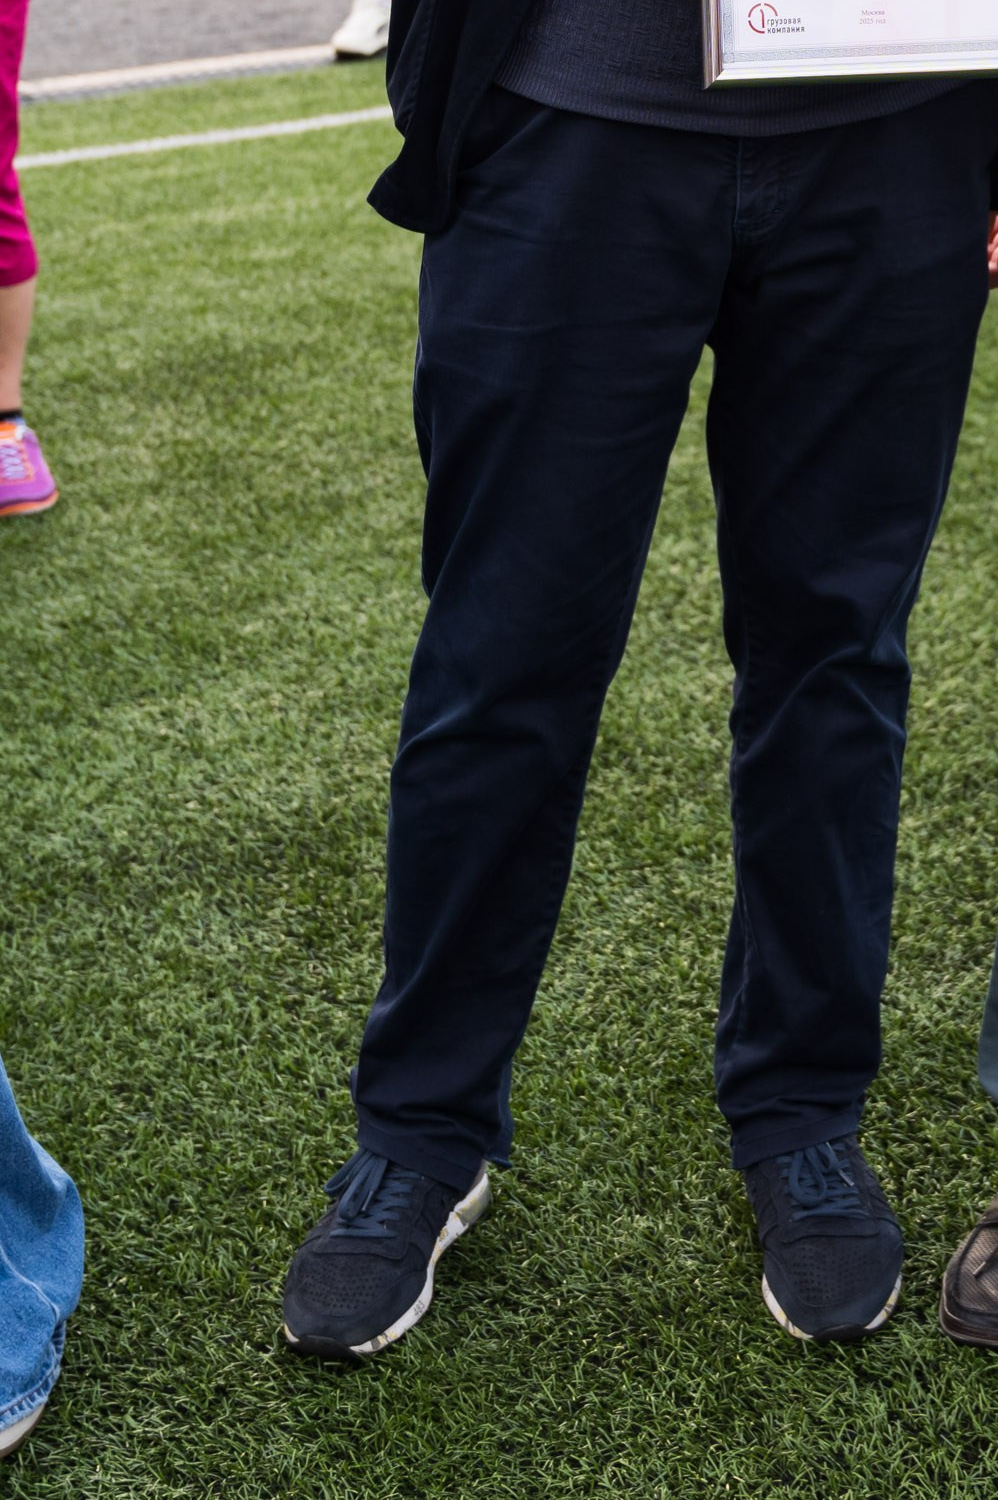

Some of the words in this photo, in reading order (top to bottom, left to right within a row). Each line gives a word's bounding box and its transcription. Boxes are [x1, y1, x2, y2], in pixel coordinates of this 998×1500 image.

[766, 17, 802, 27] грузовая
[859, 17, 874, 25] 2025
[767, 26, 806, 34] компания
